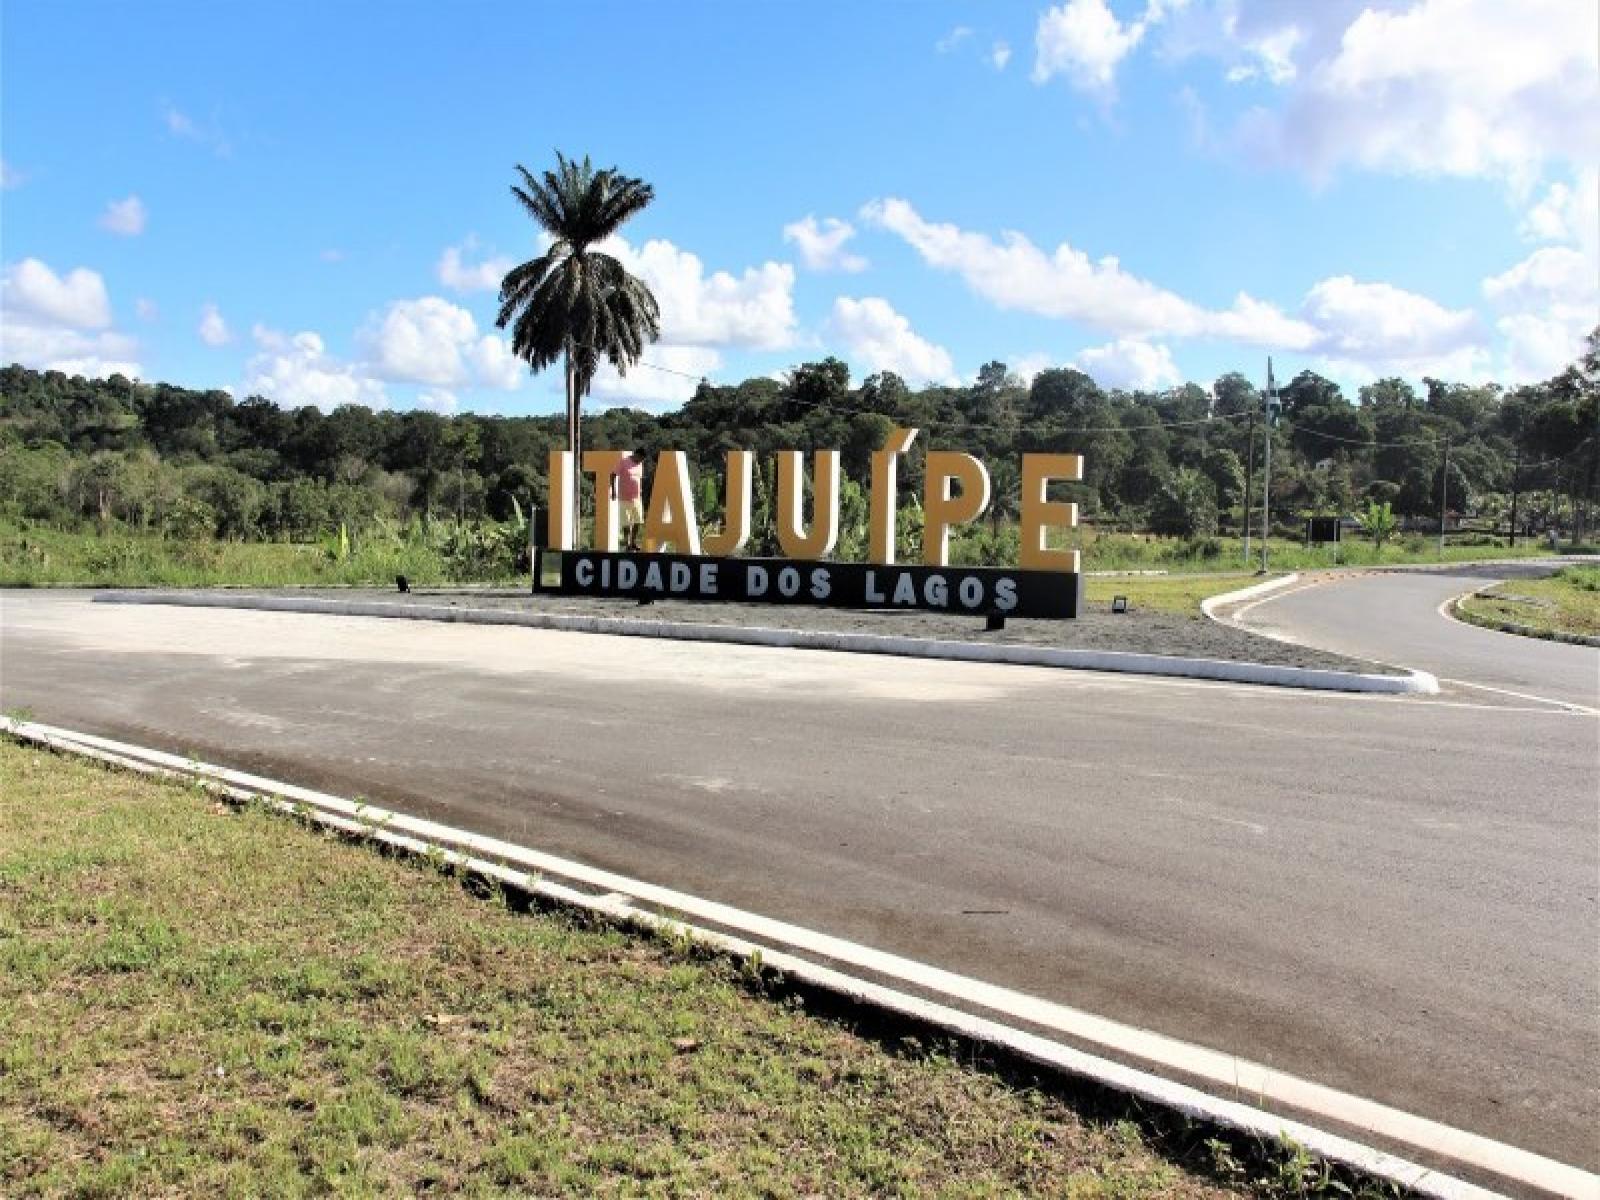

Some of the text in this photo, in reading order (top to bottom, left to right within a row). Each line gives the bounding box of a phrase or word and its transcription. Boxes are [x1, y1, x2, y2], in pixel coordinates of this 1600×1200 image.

[548, 428, 1084, 573] ITAJUÍPE
[575, 558, 1019, 610] CIDADE DOS LAGOS
